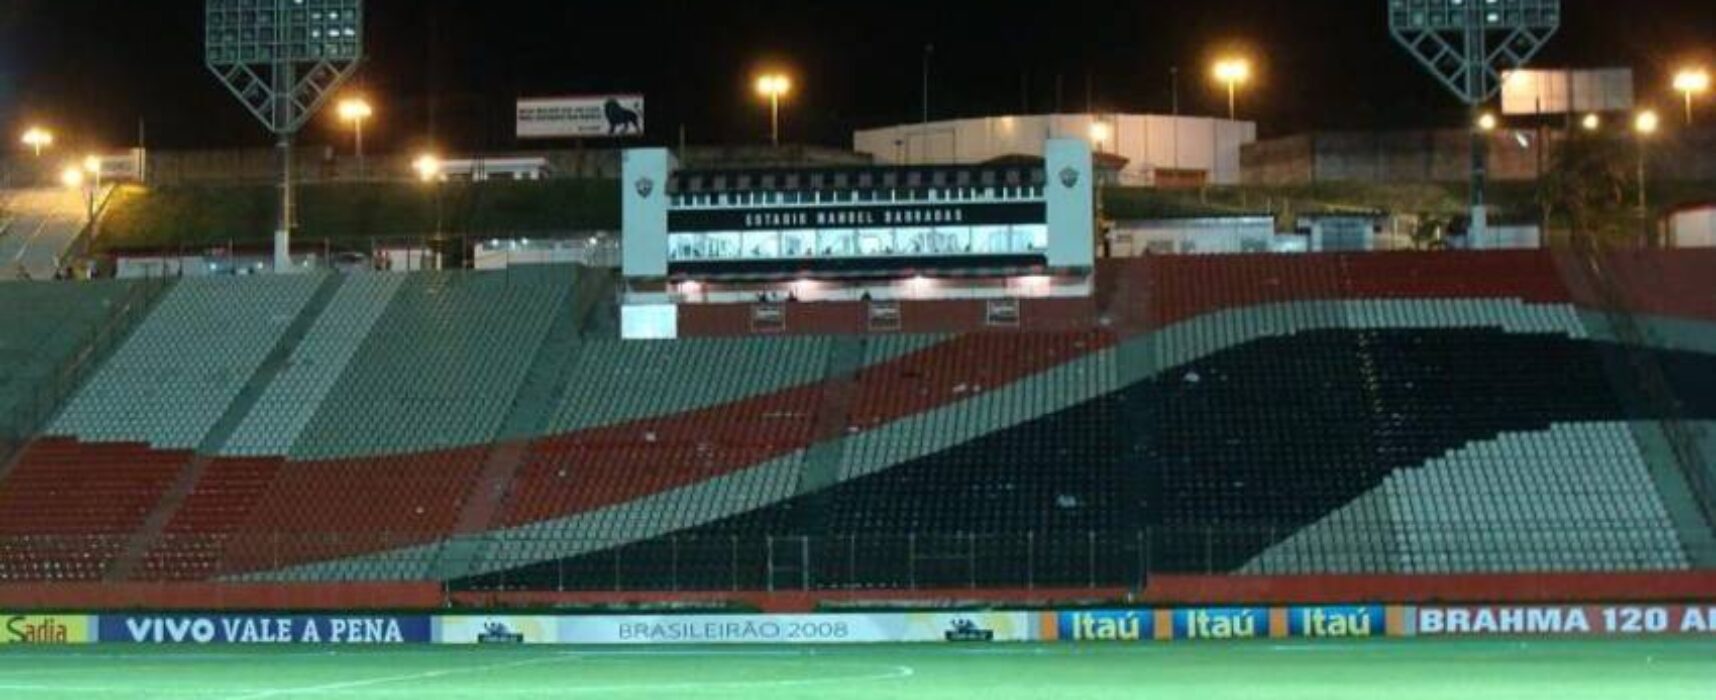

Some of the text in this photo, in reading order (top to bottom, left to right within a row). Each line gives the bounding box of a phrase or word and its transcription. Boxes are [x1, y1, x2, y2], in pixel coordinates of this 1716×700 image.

[6, 616, 68, 643] Sadia
[126, 617, 404, 643] VIVO VALE A PENA
[619, 620, 849, 639] BRASILEIRÃO 2008
[1071, 611, 1140, 640] Itaú
[1187, 609, 1255, 638] Itaú
[1302, 607, 1370, 636] Itaú
[1419, 608, 1590, 632] BRAHMA
[1603, 607, 1667, 631] 120
